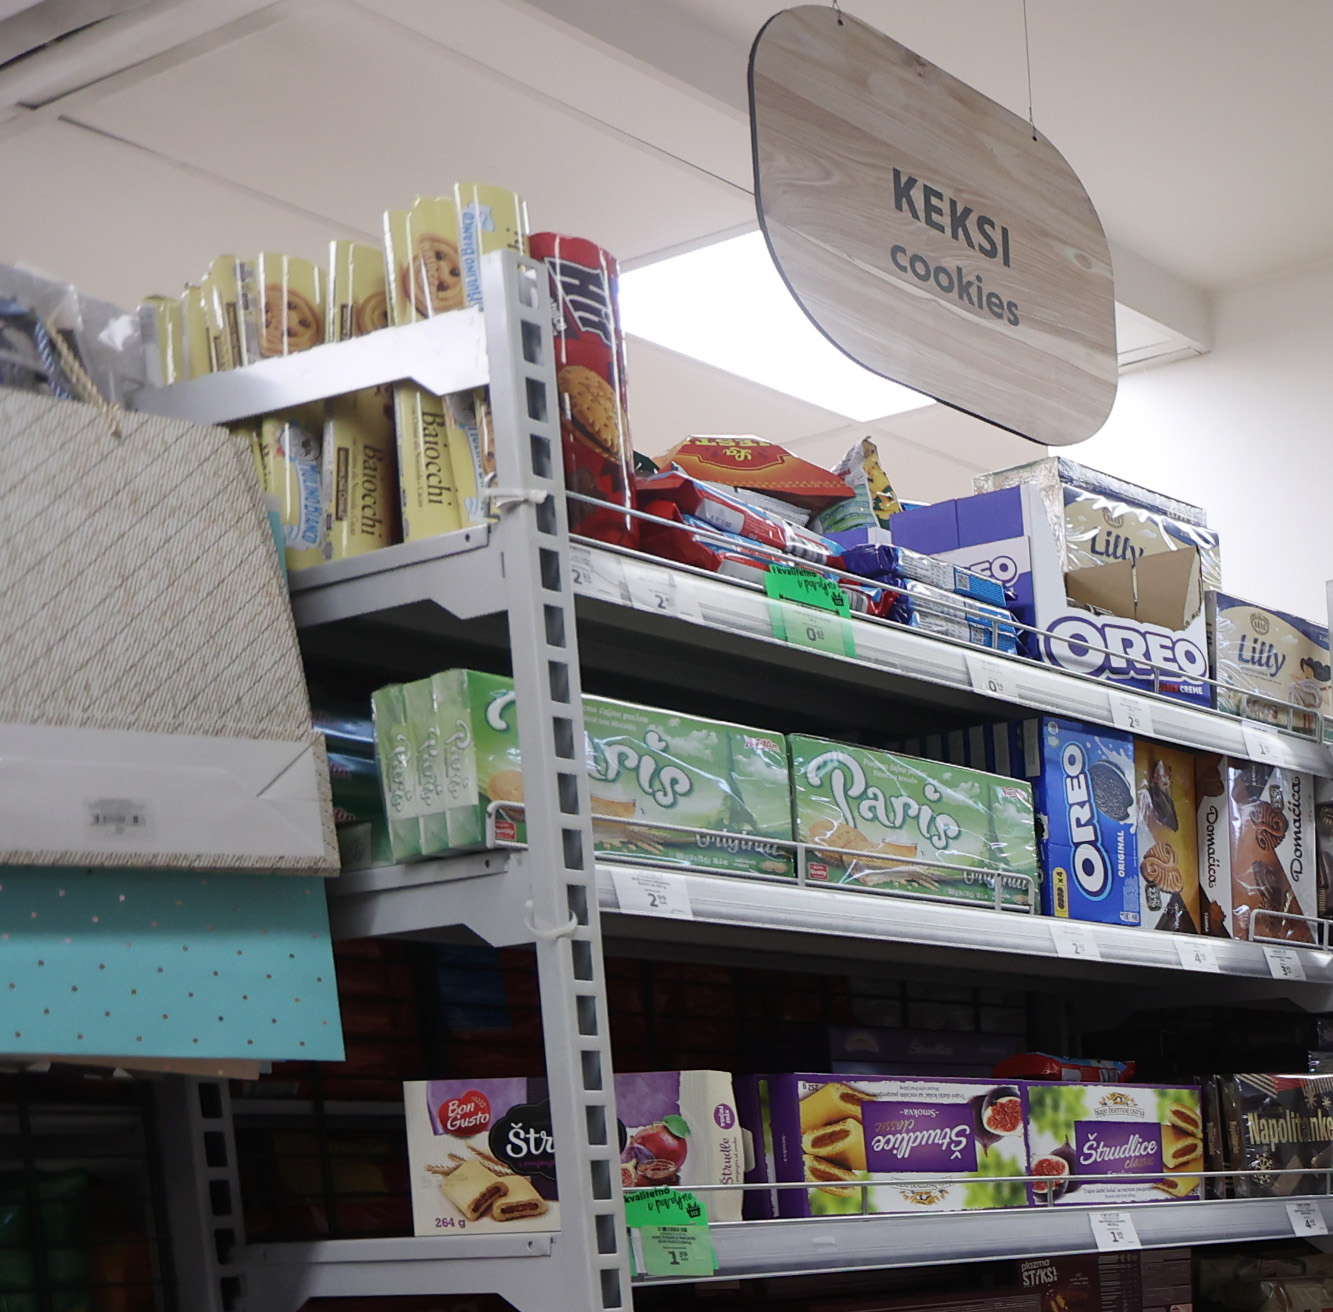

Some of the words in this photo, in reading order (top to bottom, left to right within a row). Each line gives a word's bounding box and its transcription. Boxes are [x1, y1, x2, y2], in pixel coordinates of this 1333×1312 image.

[893, 168, 1011, 268] KEKSI
[544, 257, 614, 346] HIT
[890, 245, 1020, 326] cookies
[421, 409, 452, 508] Baiocchi
[361, 442, 384, 538] Baiocchi
[1090, 531, 1144, 568] Lilly
[1049, 616, 1209, 681] OREO
[1238, 634, 1285, 678] Lilly
[1179, 685, 1203, 695] CREME
[805, 749, 961, 851] Paris
[1061, 741, 1112, 901] OREO
[1205, 805, 1219, 889] Domaćica
[1289, 775, 1303, 883] Domaćica
[1117, 830, 1126, 878] ORIGINAL
[446, 1111, 490, 1132] Gusto
[448, 1100, 476, 1118] Bon
[719, 1136, 734, 1185] Štrudle
[871, 1123, 971, 1160] Štrudlice
[1079, 1132, 1158, 1166] Štrudlice
[1124, 1155, 1155, 1170] classic
[435, 1217, 455, 1229] 264
[458, 1219, 466, 1230] g
[1020, 1259, 1050, 1273] plazma
